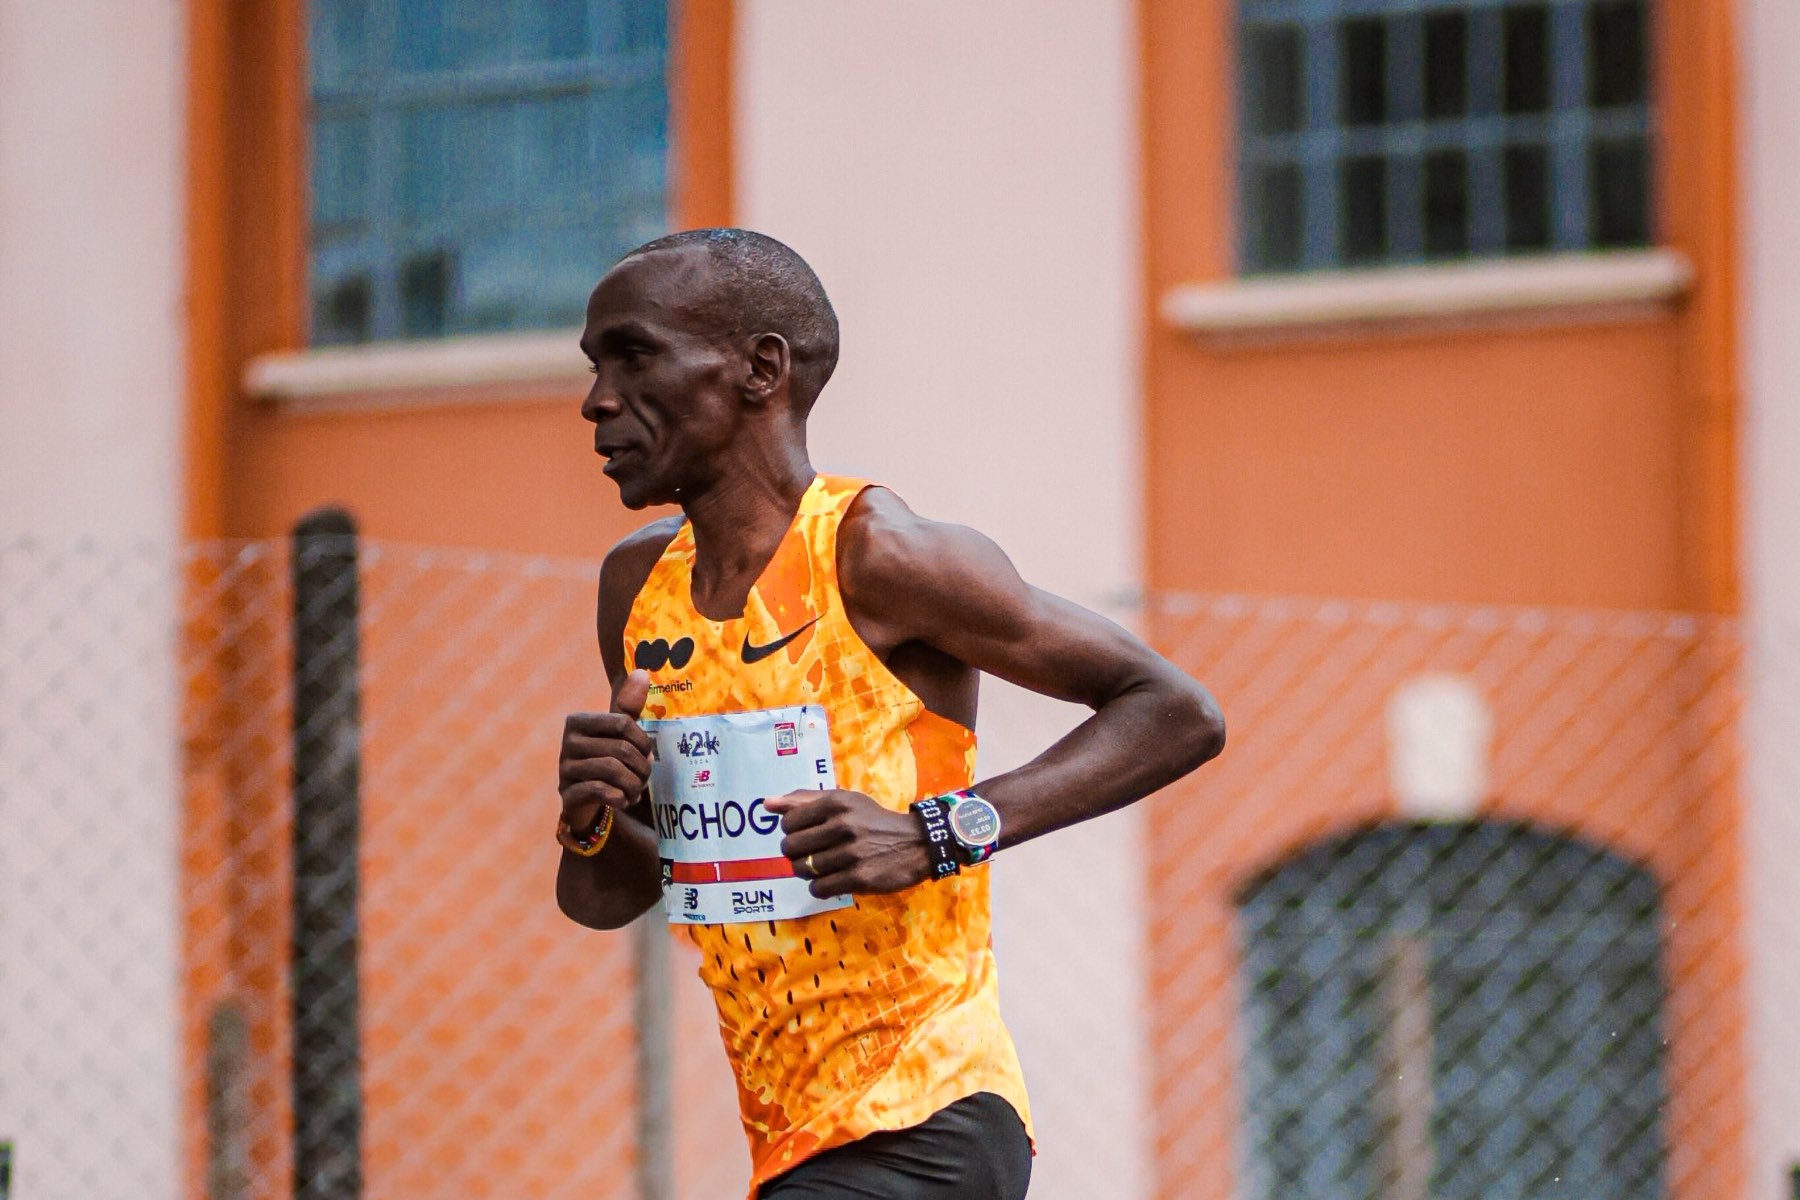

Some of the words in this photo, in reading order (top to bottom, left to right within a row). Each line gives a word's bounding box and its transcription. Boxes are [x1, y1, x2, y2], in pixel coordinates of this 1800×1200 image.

[655, 798, 779, 840] KIPCHOG
[713, 862, 721, 882] 1
[731, 889, 774, 906] RUN
[733, 904, 775, 915] SPORTS
